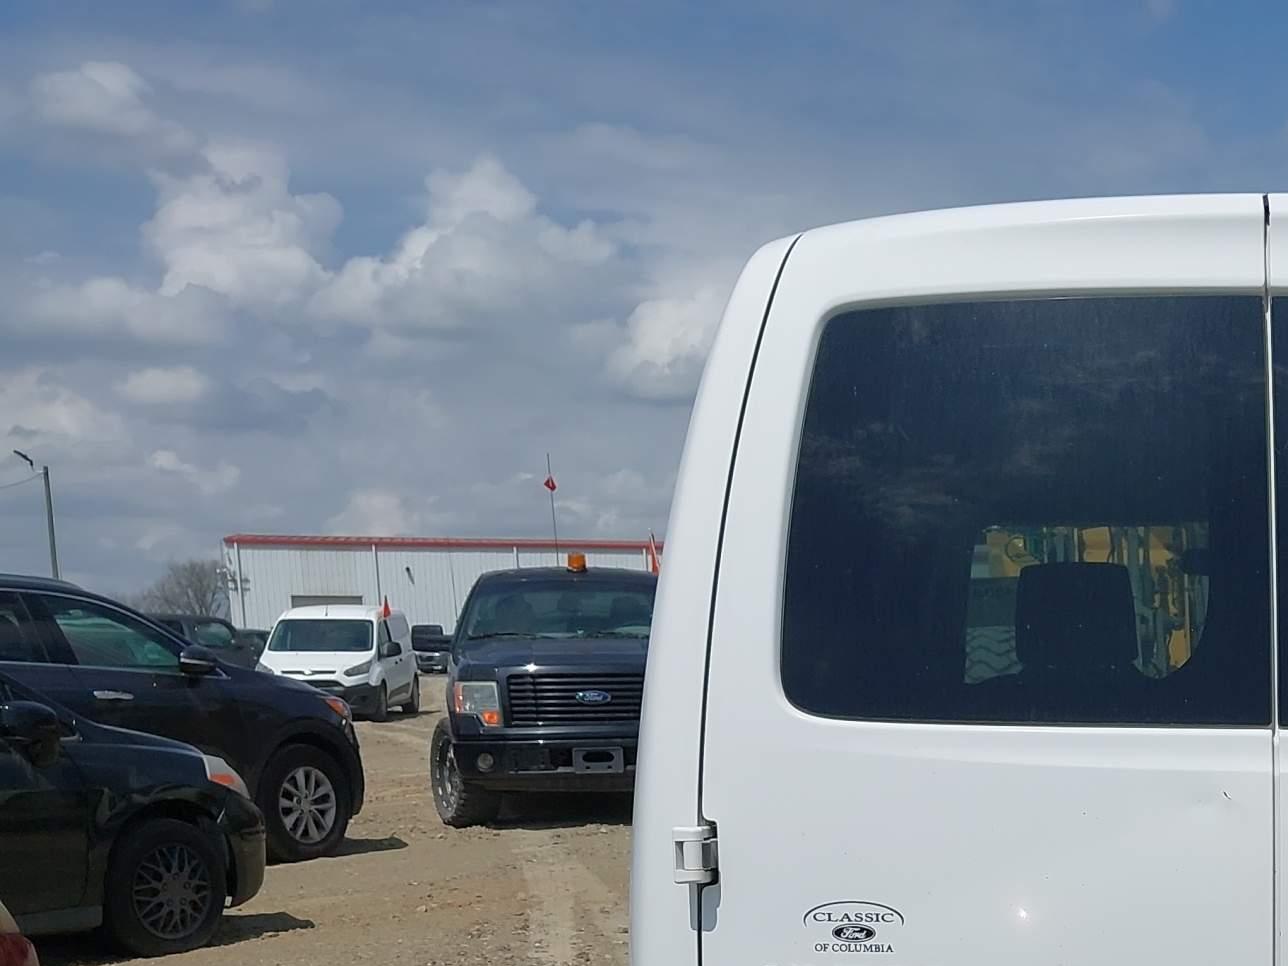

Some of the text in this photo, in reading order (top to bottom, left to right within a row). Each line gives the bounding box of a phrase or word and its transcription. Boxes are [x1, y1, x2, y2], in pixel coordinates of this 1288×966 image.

[813, 912, 895, 923] CLASSIC
[840, 927, 867, 939] Ford
[814, 943, 893, 953] OF COLUMBIA
